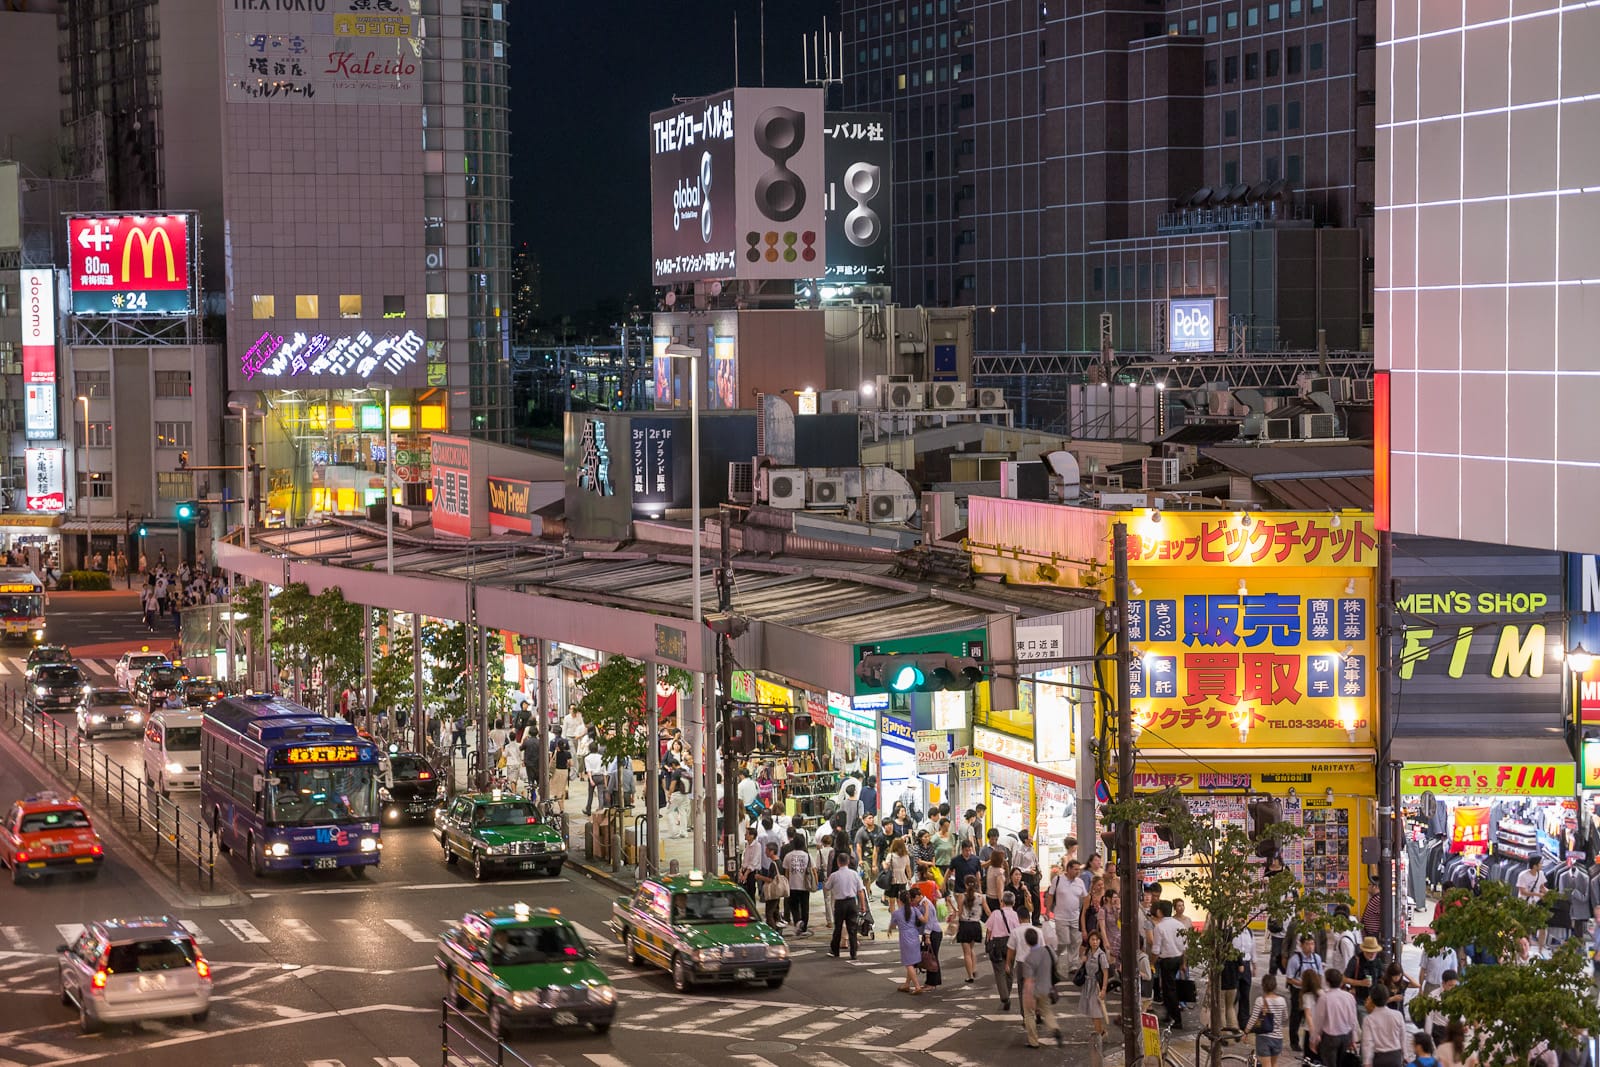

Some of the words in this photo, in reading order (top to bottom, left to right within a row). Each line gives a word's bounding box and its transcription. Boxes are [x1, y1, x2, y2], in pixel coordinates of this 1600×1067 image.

[324, 51, 416, 79] Kaleido
[85, 256, 110, 274] 80m
[30, 276, 42, 337] docomo
[127, 292, 148, 309] 24
[1174, 308, 1209, 337] PePe
[633, 429, 644, 439] 3F
[433, 468, 469, 517] 大黒屋
[1396, 591, 1471, 614] MEN'S
[1477, 592, 1547, 614] SHOP
[1182, 592, 1302, 648] 販売
[1312, 600, 1329, 638] 商品券
[1343, 600, 1361, 638] 株主券
[1016, 640, 1059, 651] 東口近道
[1399, 623, 1546, 680] FIM
[1154, 659, 1172, 694] 委託
[1182, 652, 1302, 706] 買取
[1312, 659, 1329, 693] 切手
[1343, 656, 1361, 695] 食事券
[918, 751, 945, 761] 2900
[1311, 764, 1355, 772] NARITAYA
[1413, 770, 1488, 788] men's
[1496, 766, 1556, 788] FIM
[1438, 787, 1467, 795] メンズ
[1453, 825, 1488, 843] SALE
